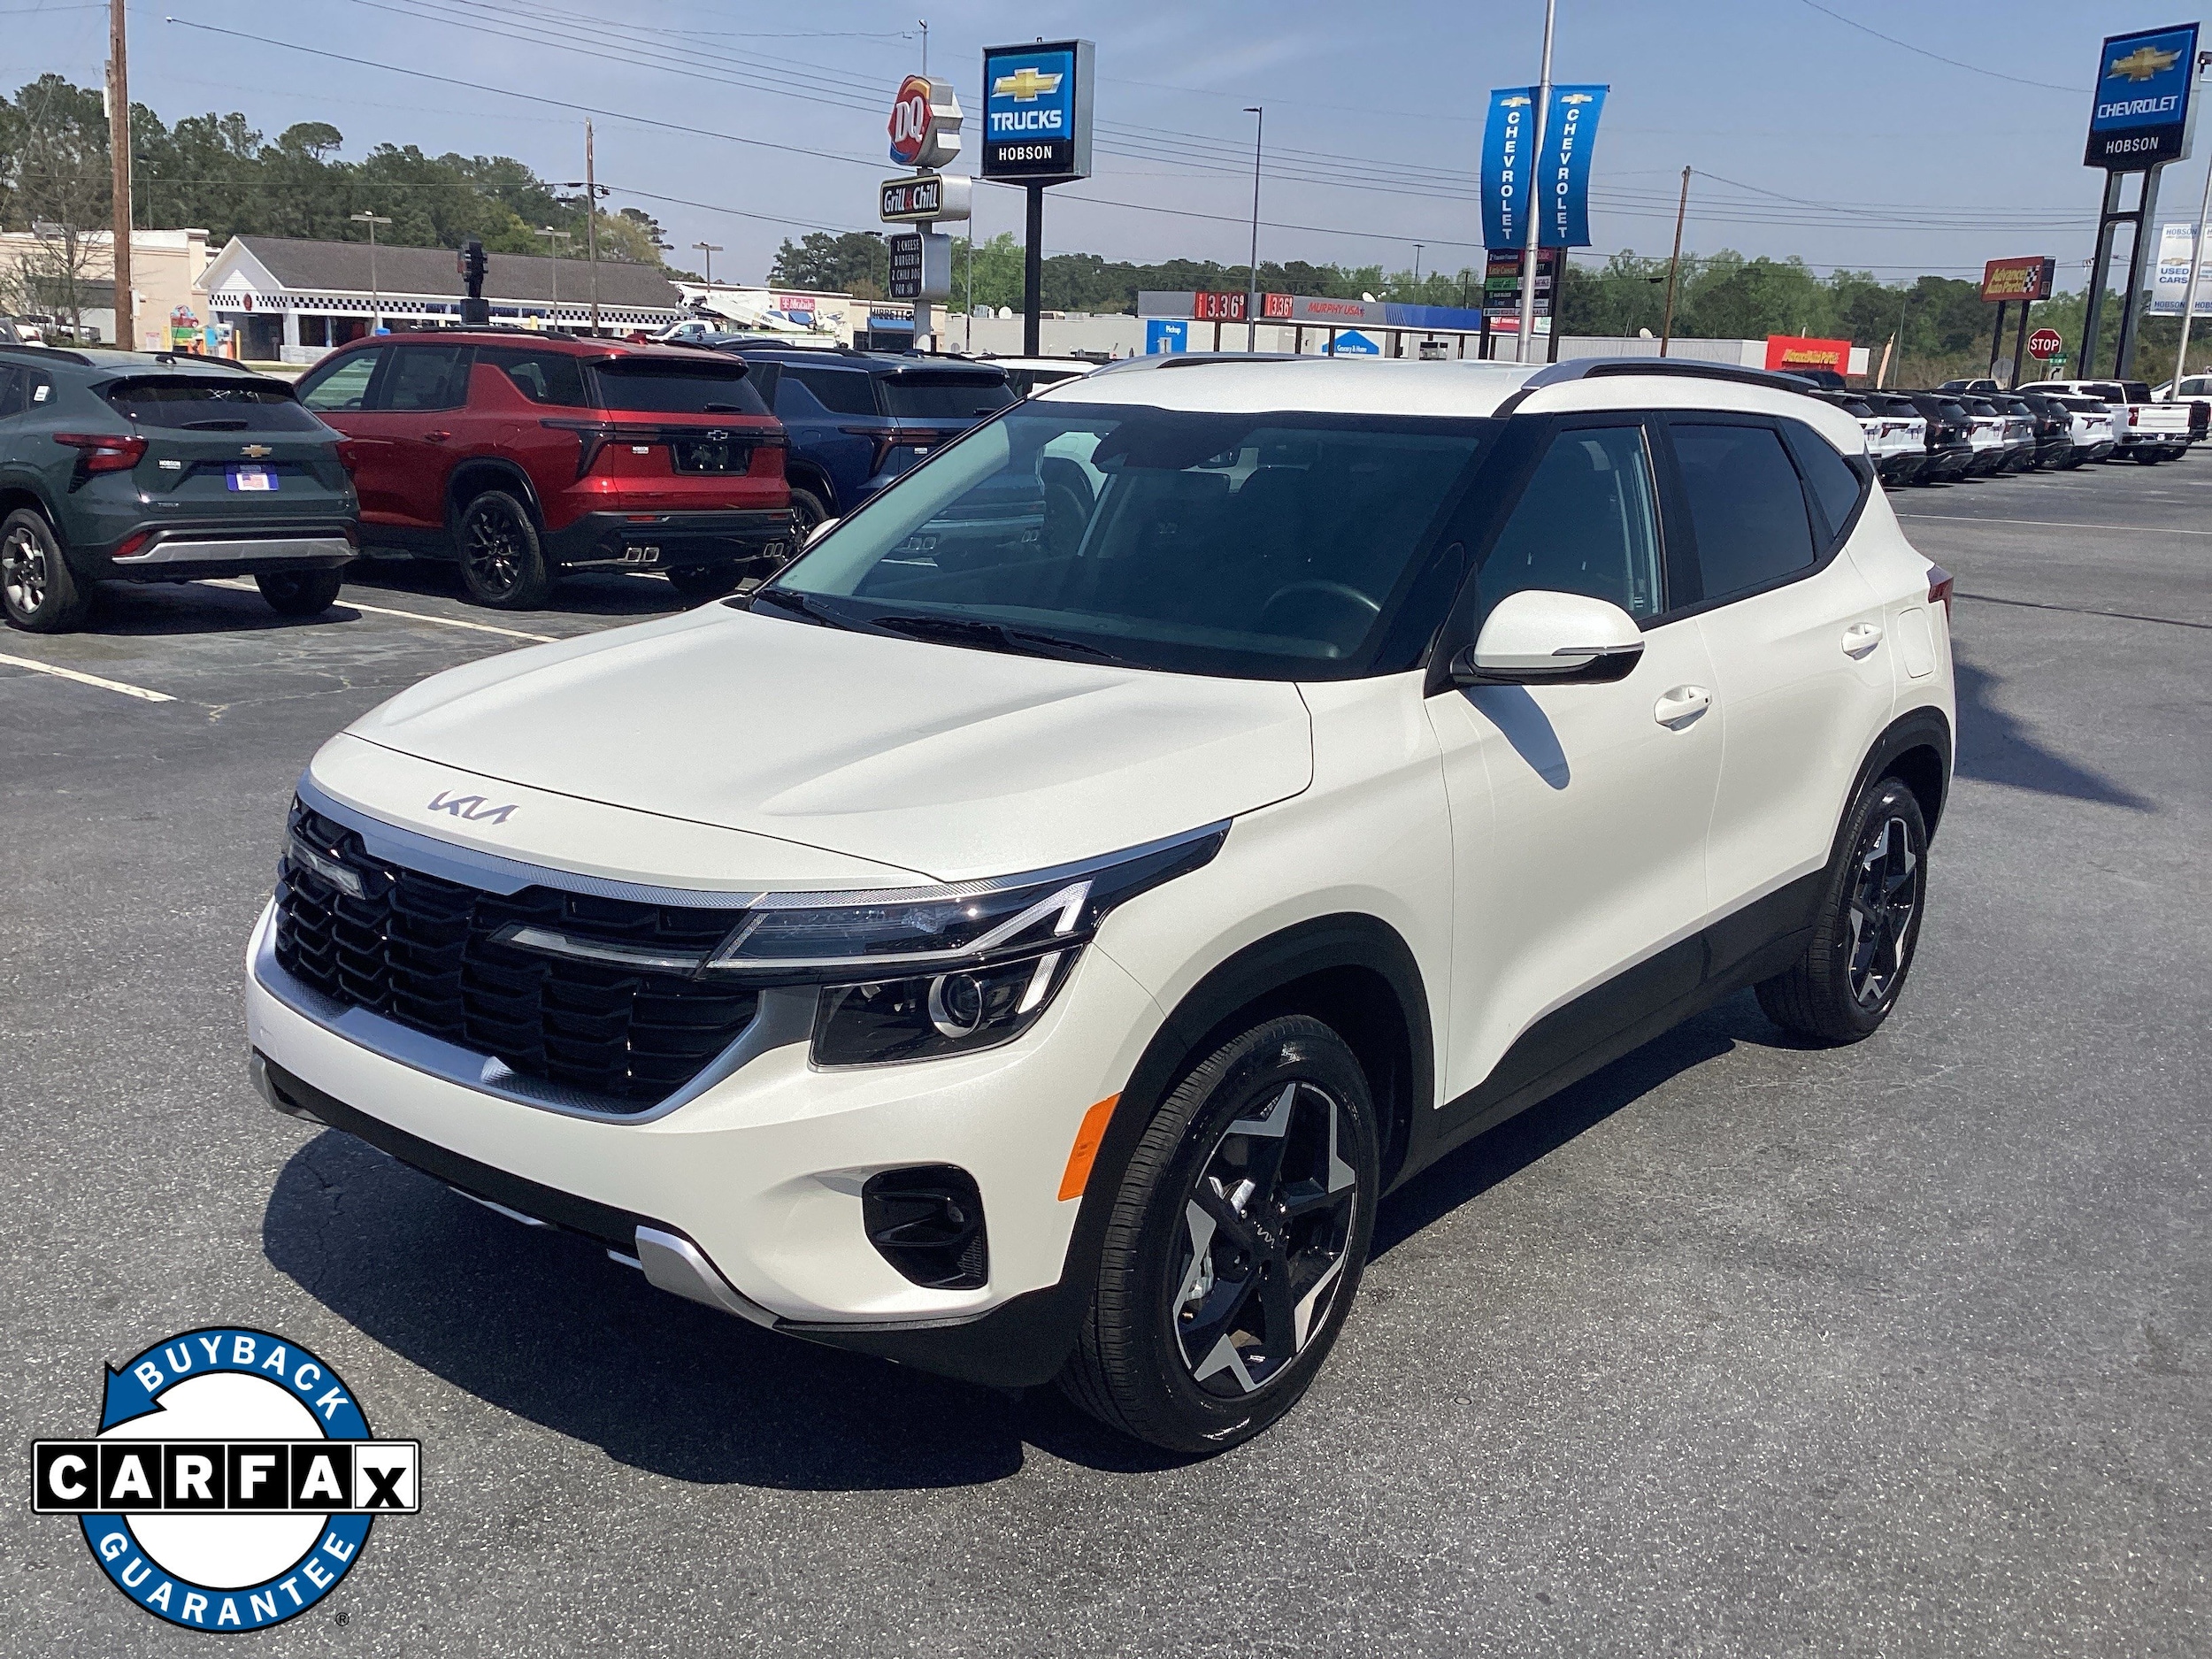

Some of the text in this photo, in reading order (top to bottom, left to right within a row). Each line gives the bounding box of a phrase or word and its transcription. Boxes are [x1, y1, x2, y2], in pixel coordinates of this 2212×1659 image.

[2098, 96, 2178, 119] CHEVROLET
[895, 96, 925, 142] DQ
[991, 110, 1062, 131] TRUCKS
[999, 146, 1052, 160] HOBSON
[2106, 136, 2159, 154] HOBSON
[1501, 111, 1520, 240] CHEVROLET
[1555, 109, 1580, 238] CHEVROLET
[884, 188, 905, 213] Grill
[913, 183, 938, 210] Chill
[1991, 268, 2026, 282] Advance
[1985, 280, 2022, 295] Auto Parts
[1308, 302, 1360, 316] MURPHY USA
[1165, 325, 1181, 335] Pickup
[2030, 338, 2059, 351] STOP
[427, 789, 520, 825] KIA
